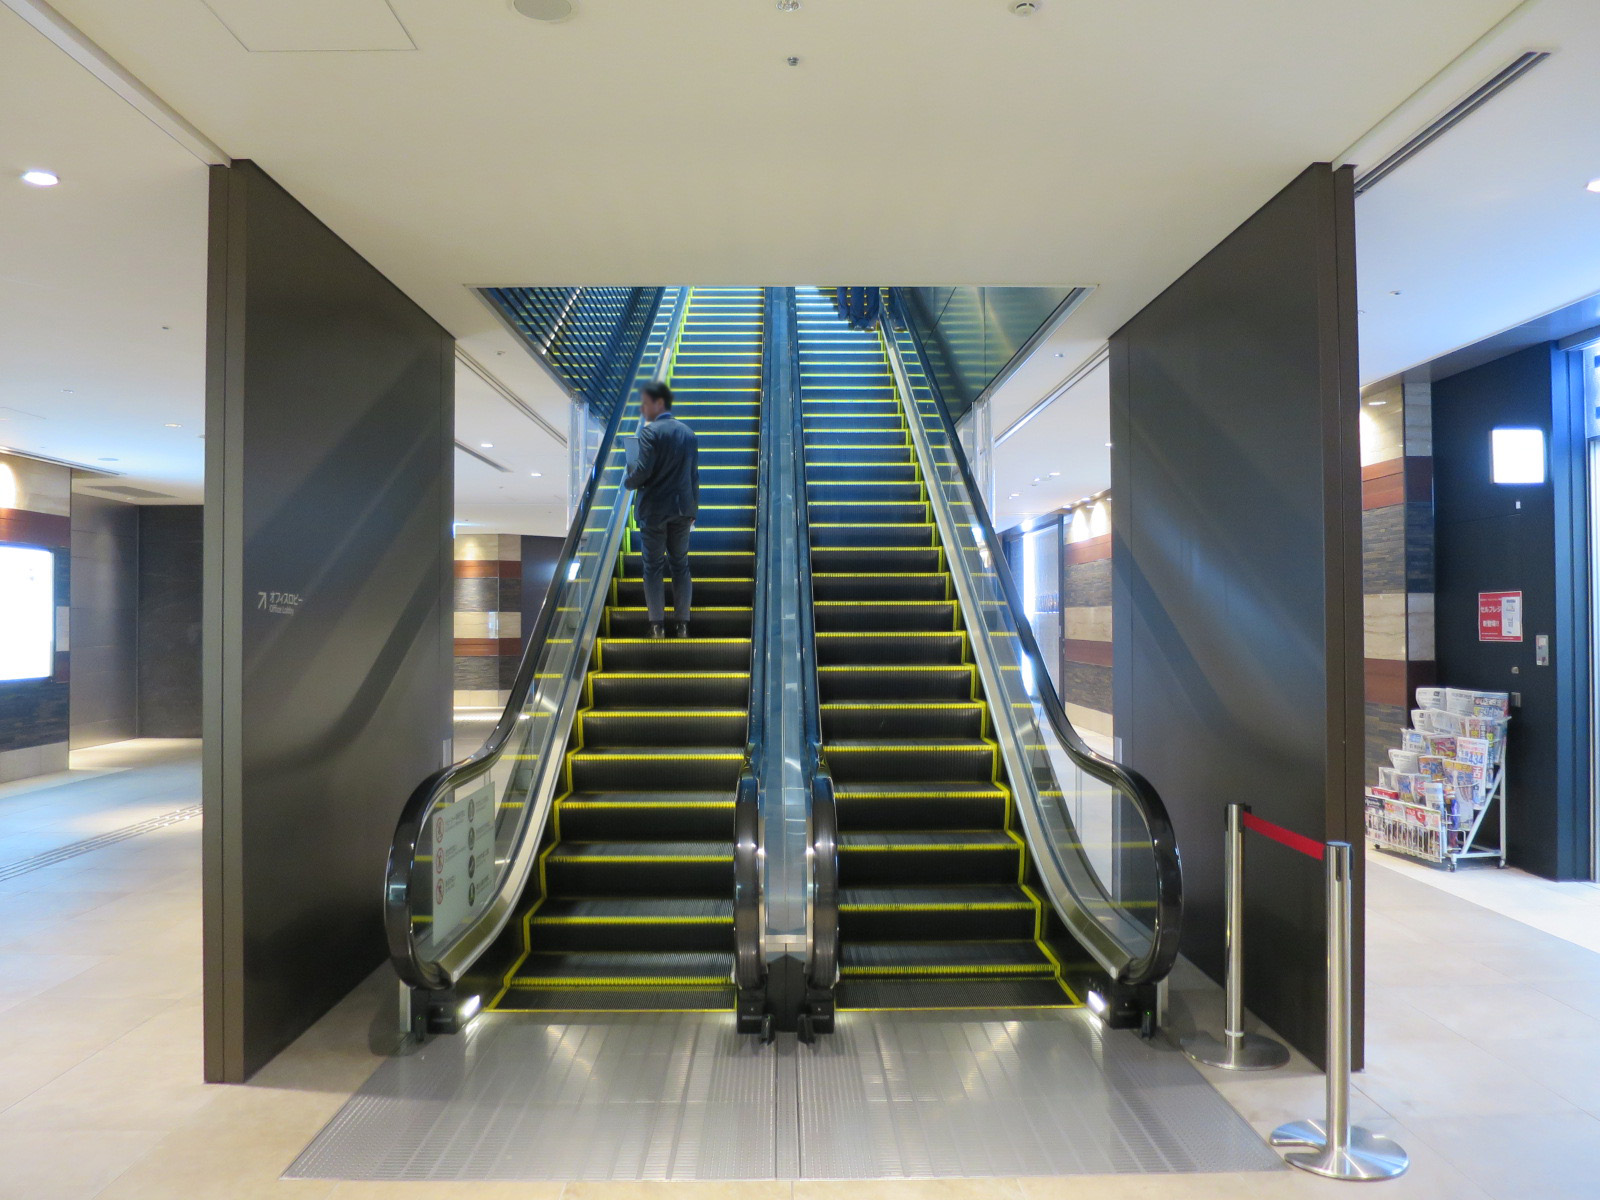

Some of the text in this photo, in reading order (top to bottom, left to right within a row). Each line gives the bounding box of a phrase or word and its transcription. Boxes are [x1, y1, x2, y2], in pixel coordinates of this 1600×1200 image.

[269, 591, 303, 605] オフィスロビー
[1480, 606, 1502, 614] セルフレジ
